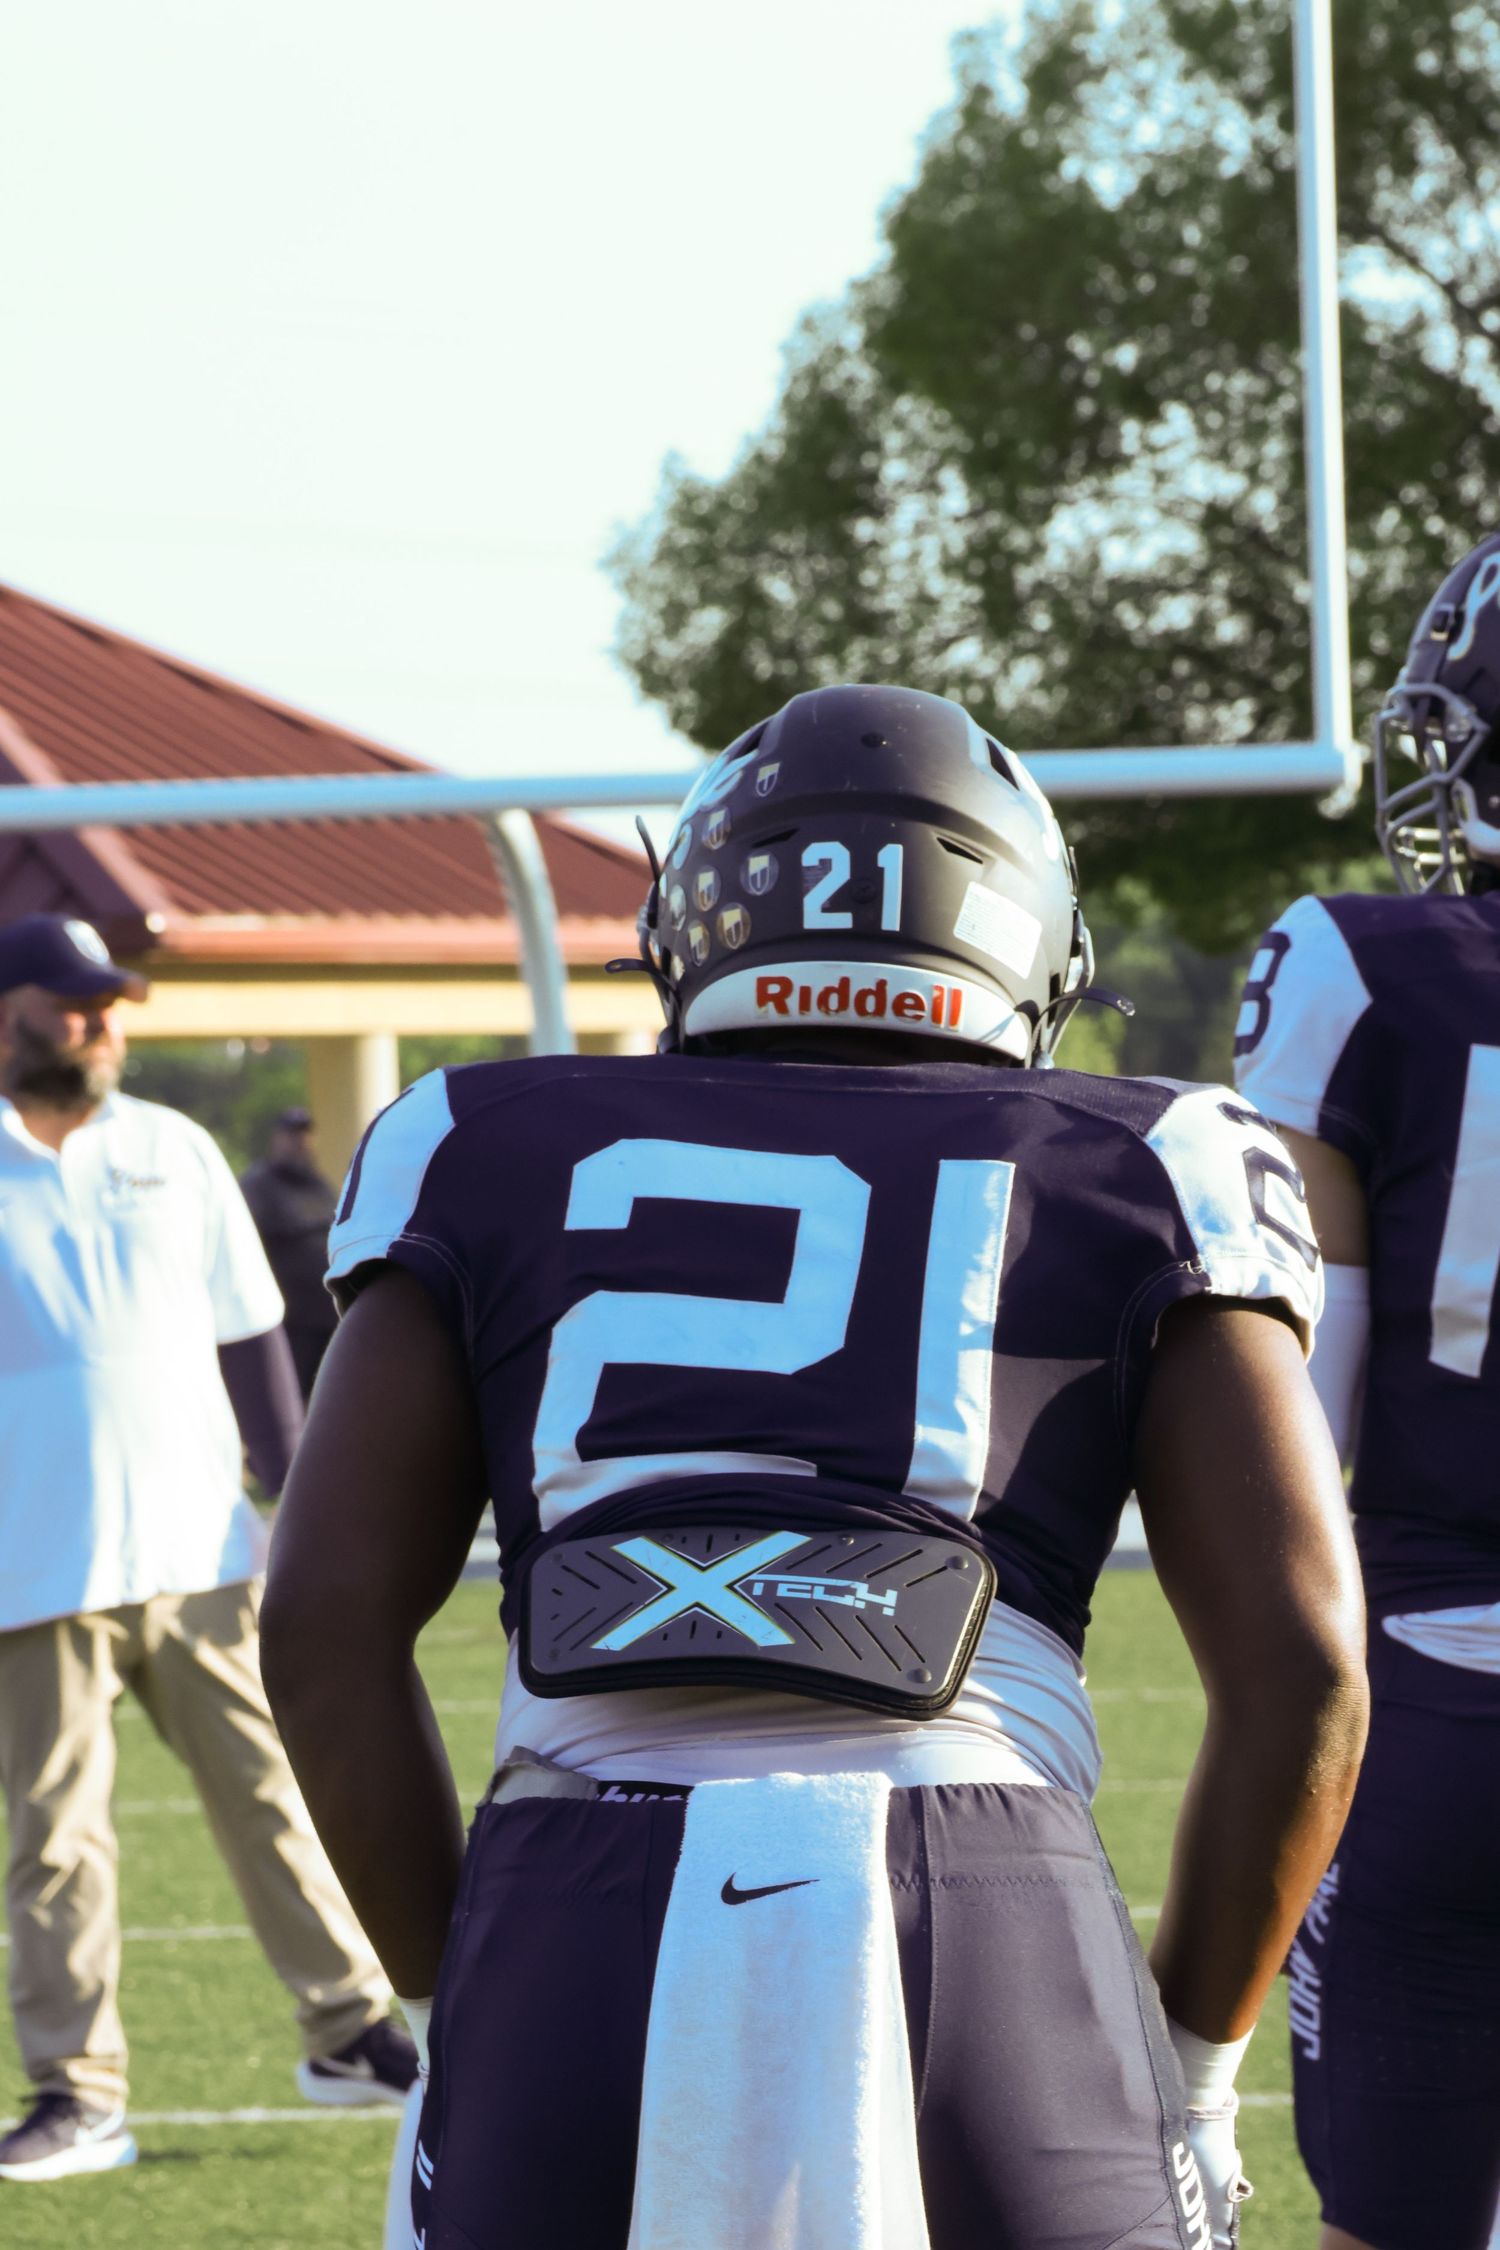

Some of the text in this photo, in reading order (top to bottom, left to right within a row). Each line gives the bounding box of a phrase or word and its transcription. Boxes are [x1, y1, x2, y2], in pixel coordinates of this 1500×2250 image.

[801, 841, 903, 932] 21
[756, 976, 963, 1031] Riddell
[532, 1138, 1016, 1532] 21
[1172, 2141, 1212, 2250] JOH
